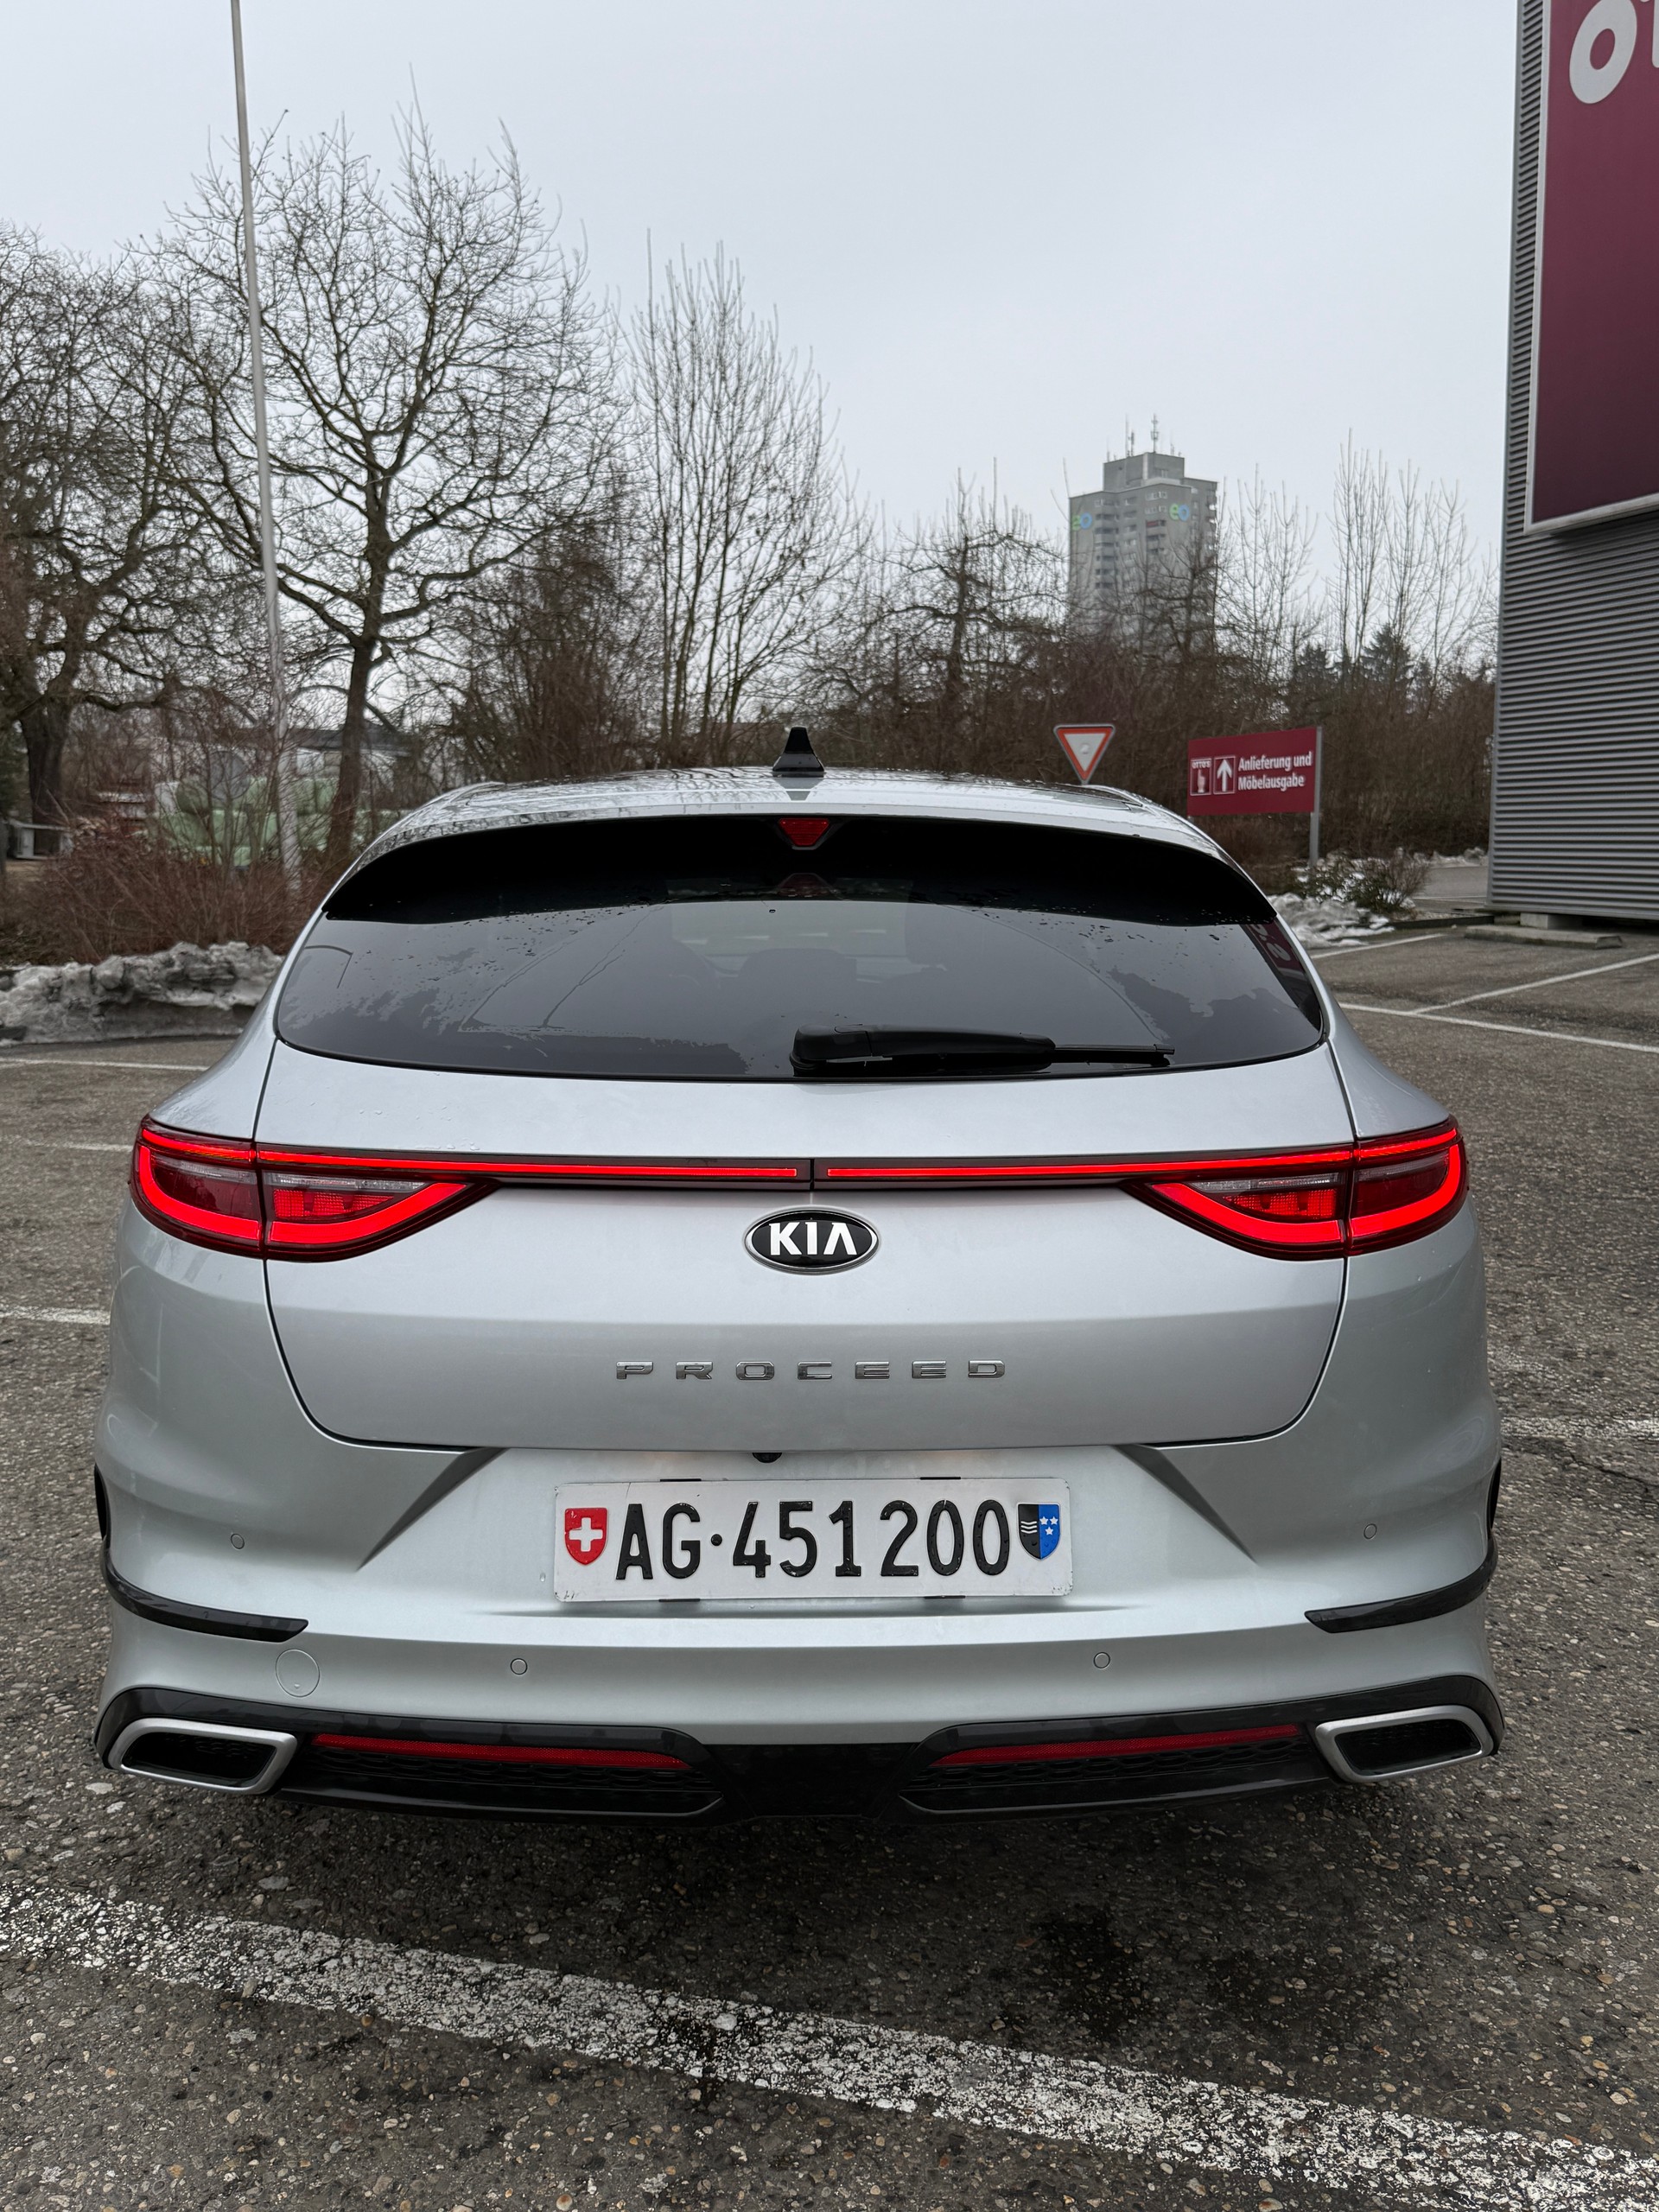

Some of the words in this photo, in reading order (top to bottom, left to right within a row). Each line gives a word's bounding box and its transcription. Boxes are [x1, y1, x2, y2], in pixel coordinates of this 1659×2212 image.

[1569, 0, 1659, 105] O
[1238, 754, 1292, 772] Anlieferung
[1294, 751, 1313, 767] und
[1238, 772, 1305, 791] Möbelausgabe
[768, 1222, 858, 1255] KIA
[615, 1359, 1006, 1381] PROCEED
